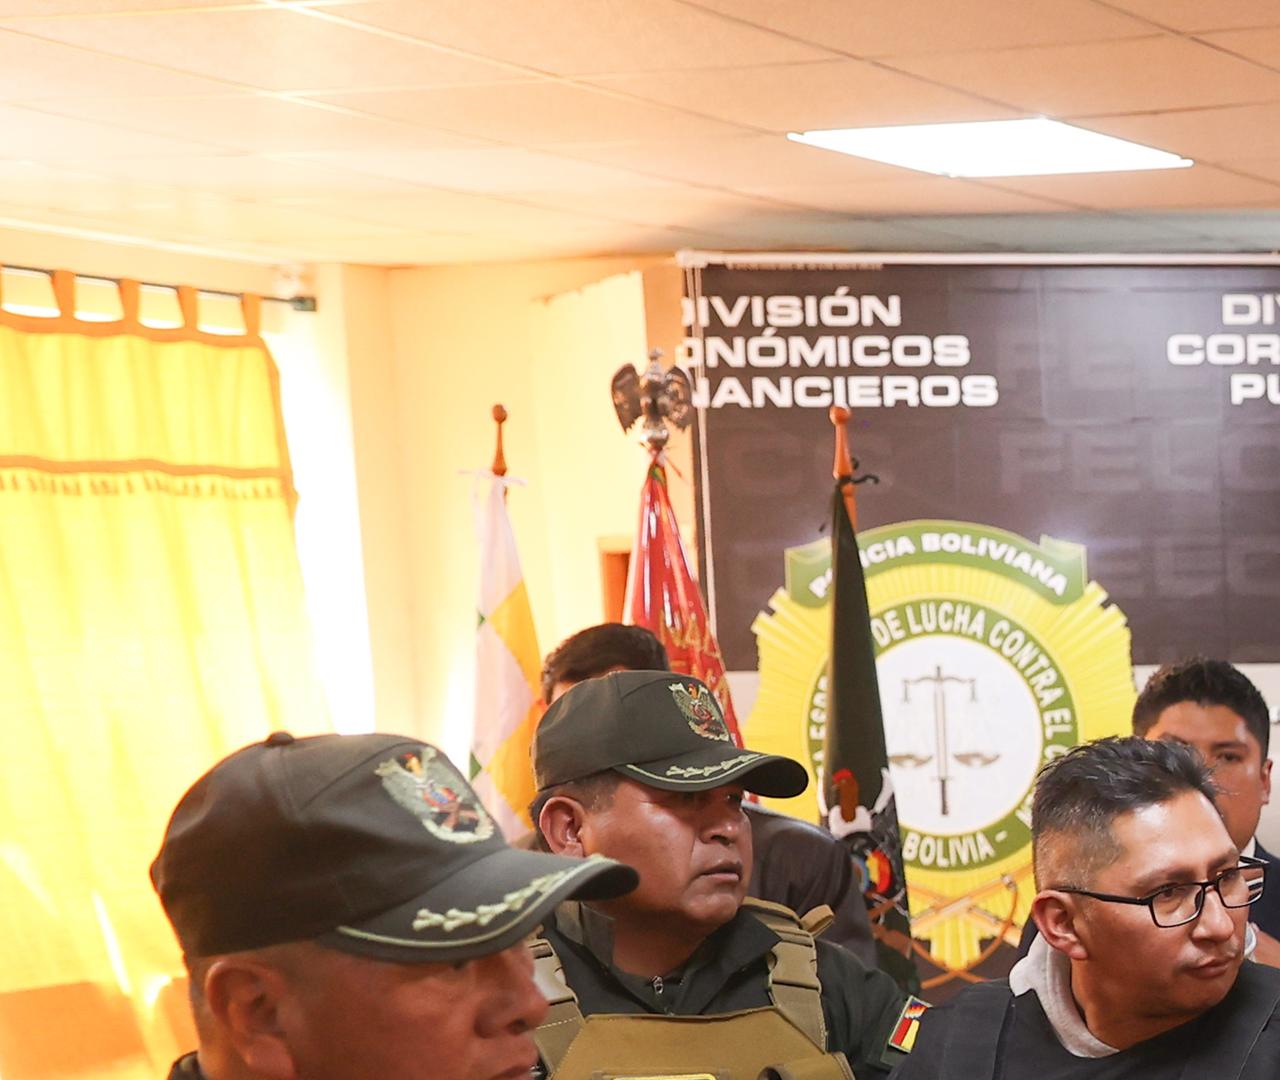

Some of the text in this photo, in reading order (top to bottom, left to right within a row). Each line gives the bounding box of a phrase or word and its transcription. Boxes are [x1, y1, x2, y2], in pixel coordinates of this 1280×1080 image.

[675, 326, 971, 368] ONÓMICOS
[921, 532, 1068, 597] BOLIVIANA
[905, 601, 987, 640] LUCHA
[988, 619, 1067, 709] CONTRA
[901, 832, 996, 868] BOLIVIA
